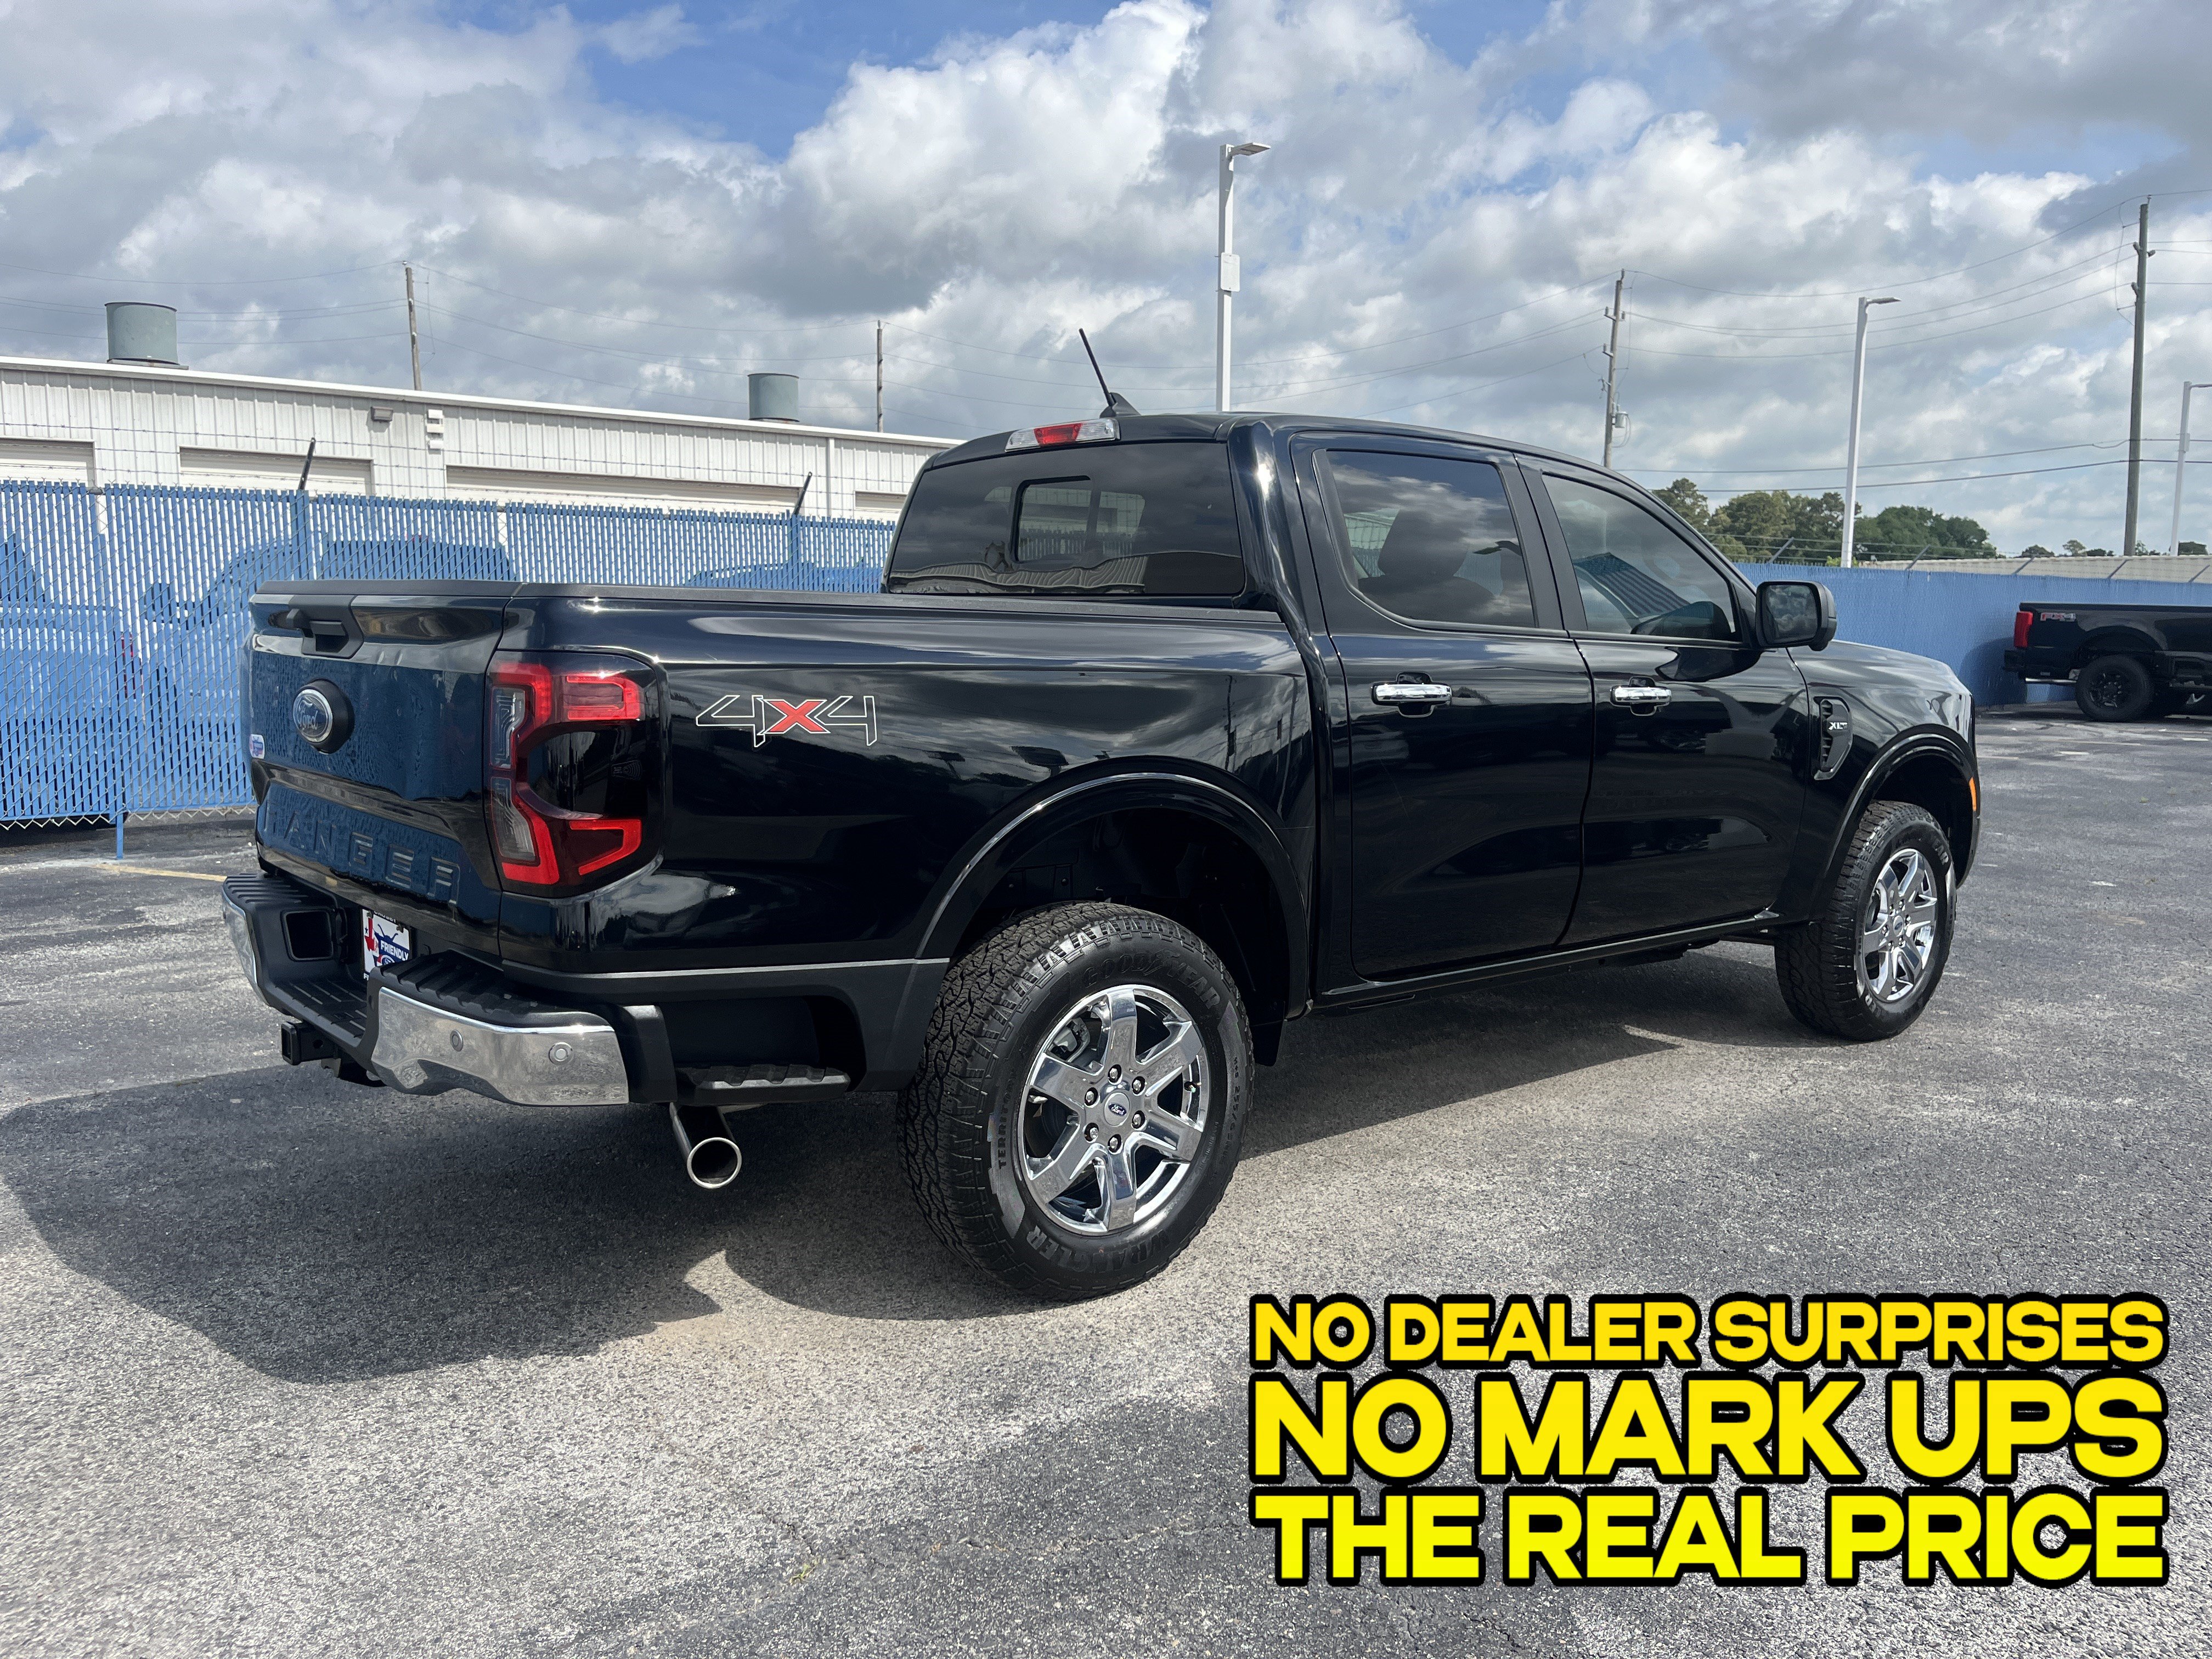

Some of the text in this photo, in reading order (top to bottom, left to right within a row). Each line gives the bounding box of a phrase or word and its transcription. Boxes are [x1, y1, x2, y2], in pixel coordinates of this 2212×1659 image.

[297, 699, 319, 730] Ford
[1828, 722, 1848, 730] XLT
[262, 799, 461, 905] ANGER
[381, 940, 409, 961] FRIENDLY
[1083, 951, 1221, 1010] GOODYEAR
[1111, 1104, 1125, 1115] Ford
